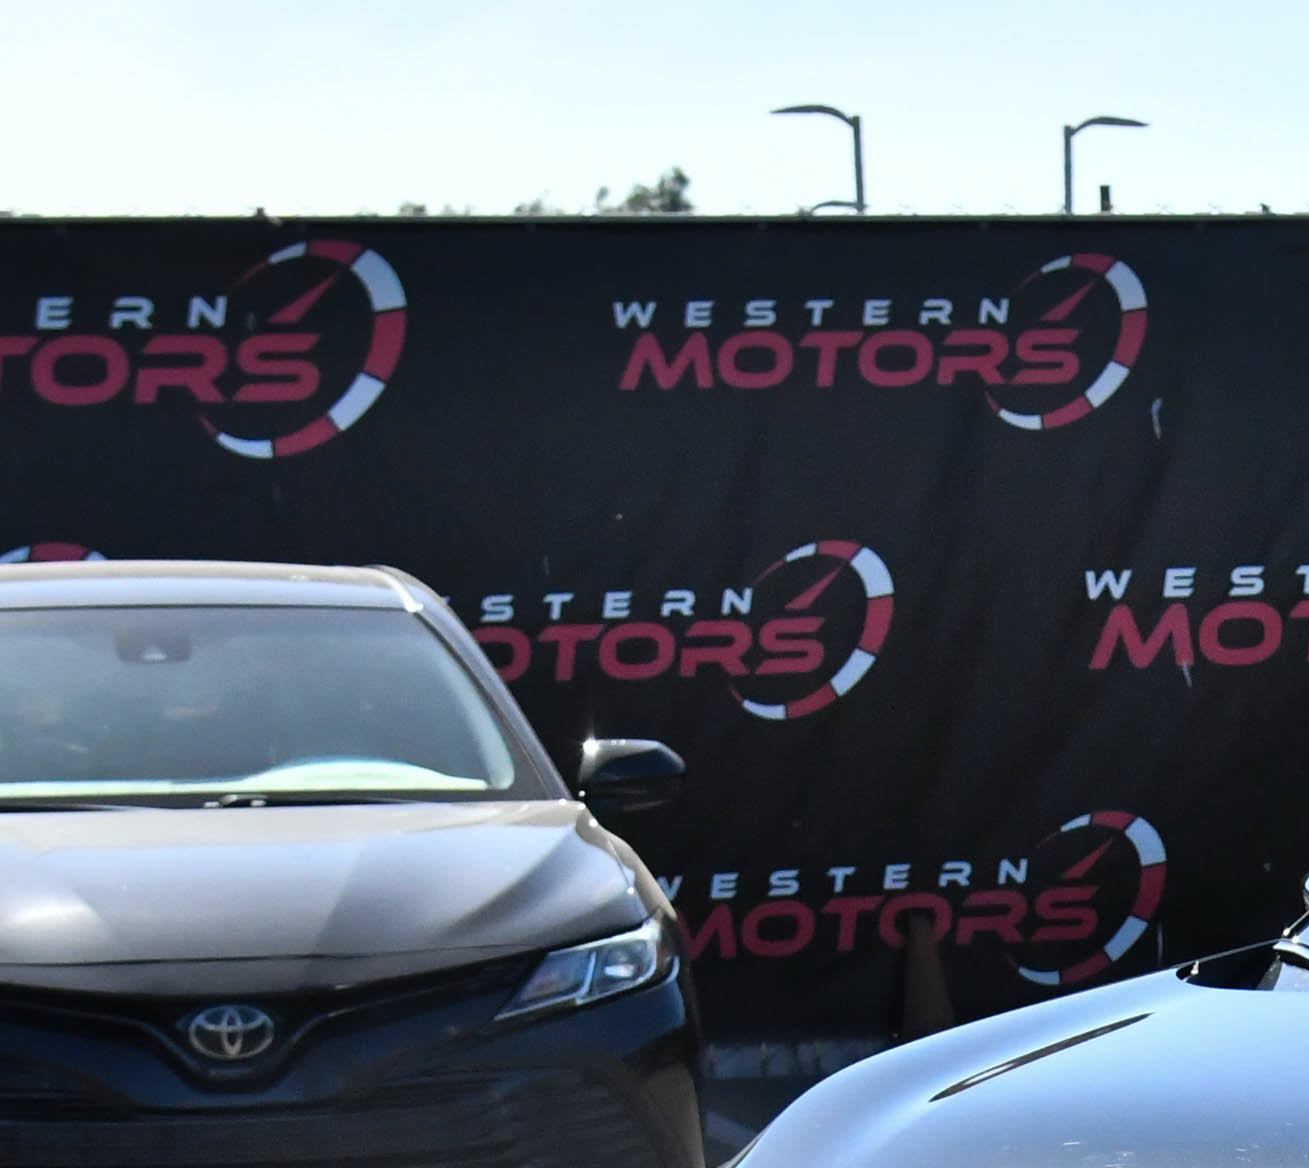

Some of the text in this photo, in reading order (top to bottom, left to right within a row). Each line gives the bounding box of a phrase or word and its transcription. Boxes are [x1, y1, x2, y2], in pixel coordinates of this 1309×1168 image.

[36, 296, 228, 330] ERN
[612, 298, 1010, 329] WESTERN
[618, 328, 1080, 391] MOTORS
[445, 587, 754, 622] STERN
